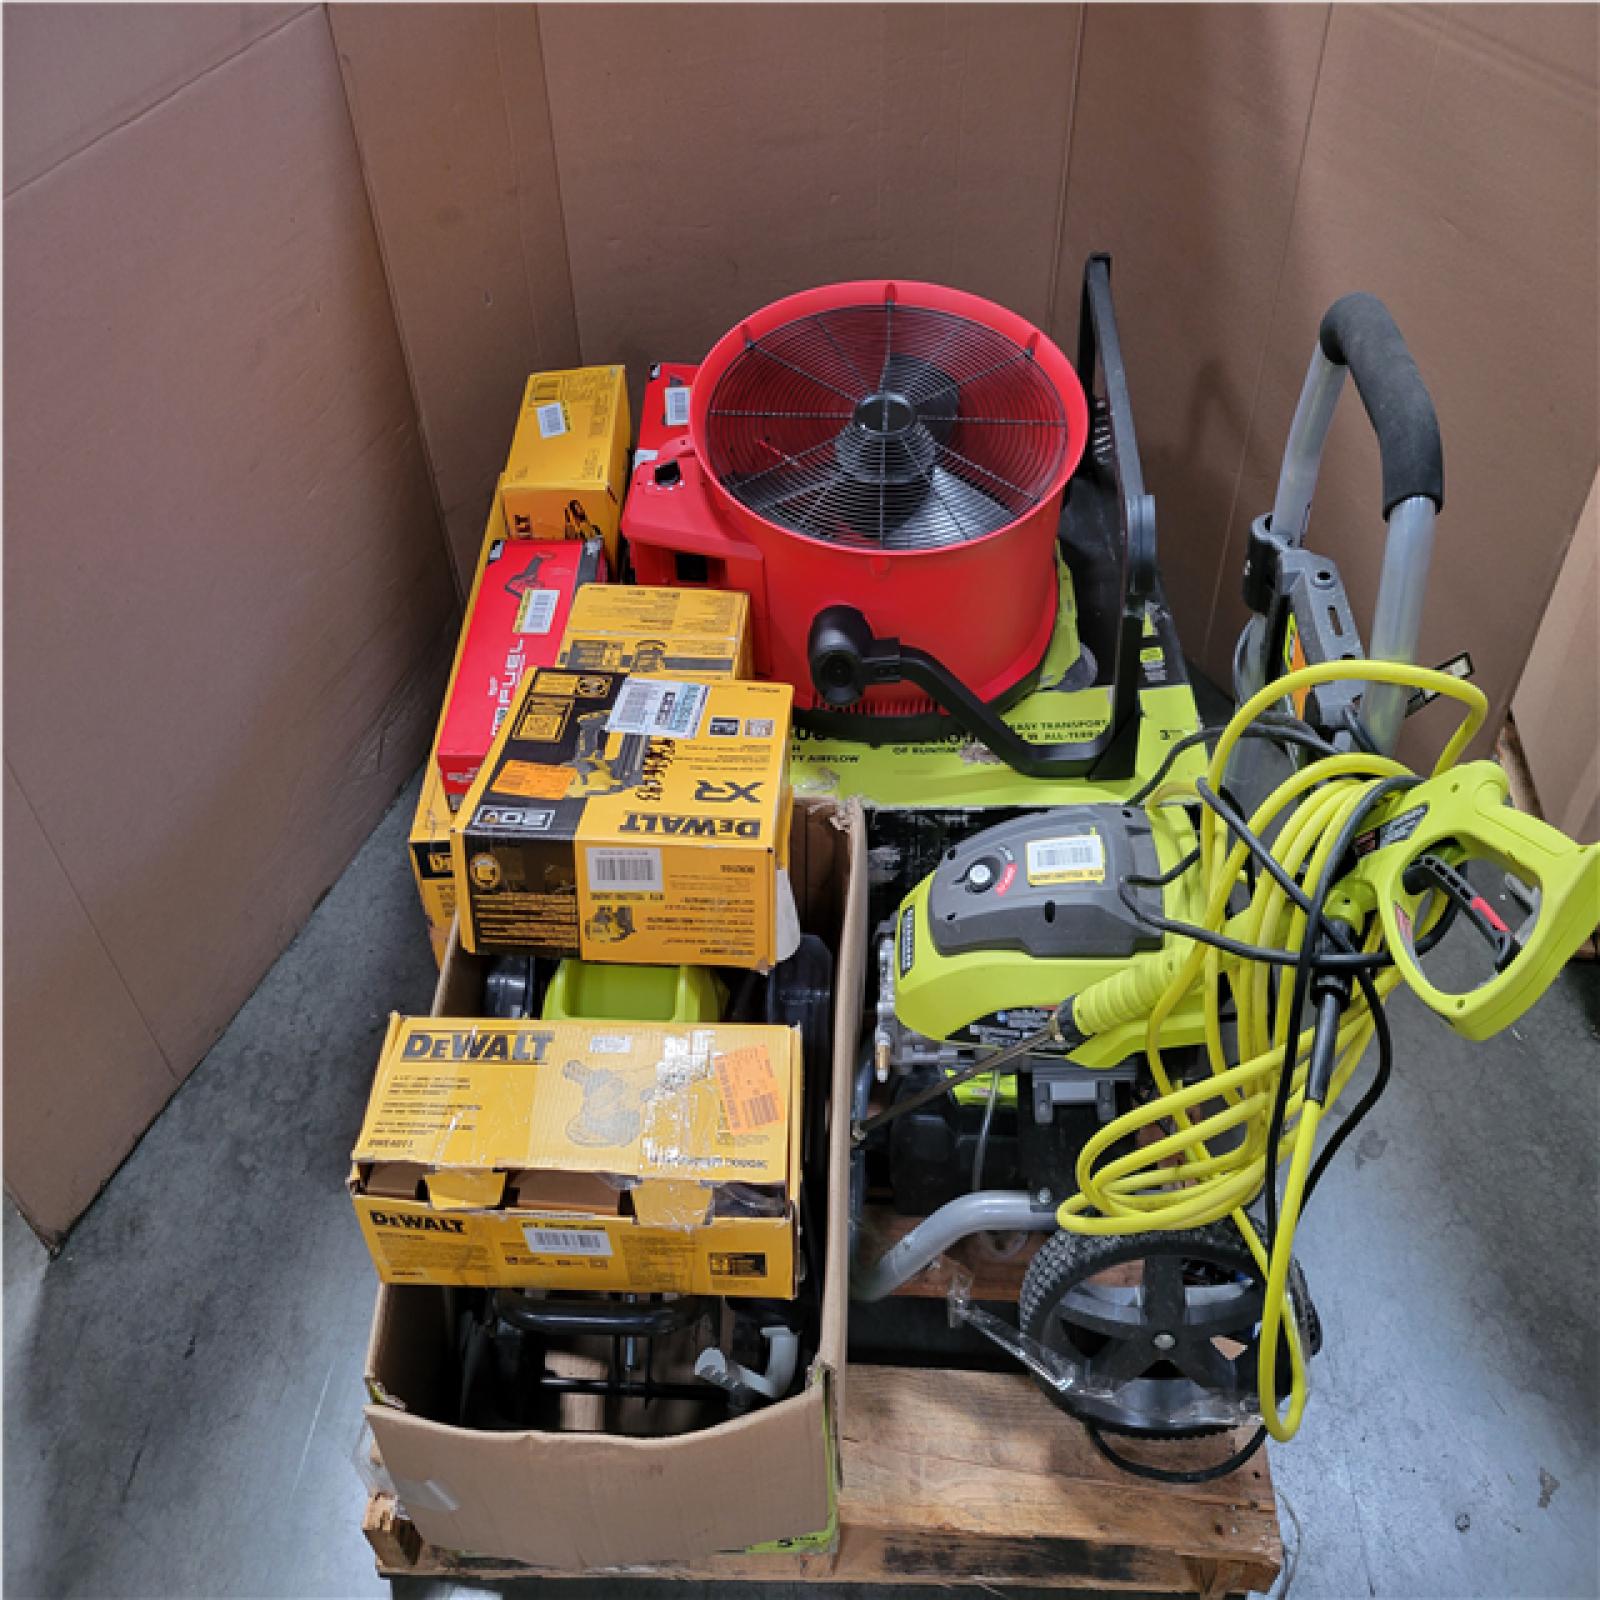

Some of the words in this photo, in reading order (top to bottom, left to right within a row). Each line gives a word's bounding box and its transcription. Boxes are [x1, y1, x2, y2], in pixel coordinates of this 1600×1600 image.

[808, 754, 860, 763] AIRFLOW
[695, 779, 765, 803] XR
[619, 814, 761, 837] DEWALT
[402, 1033, 554, 1062] DEWALT
[370, 1211, 465, 1233] DEWALT
